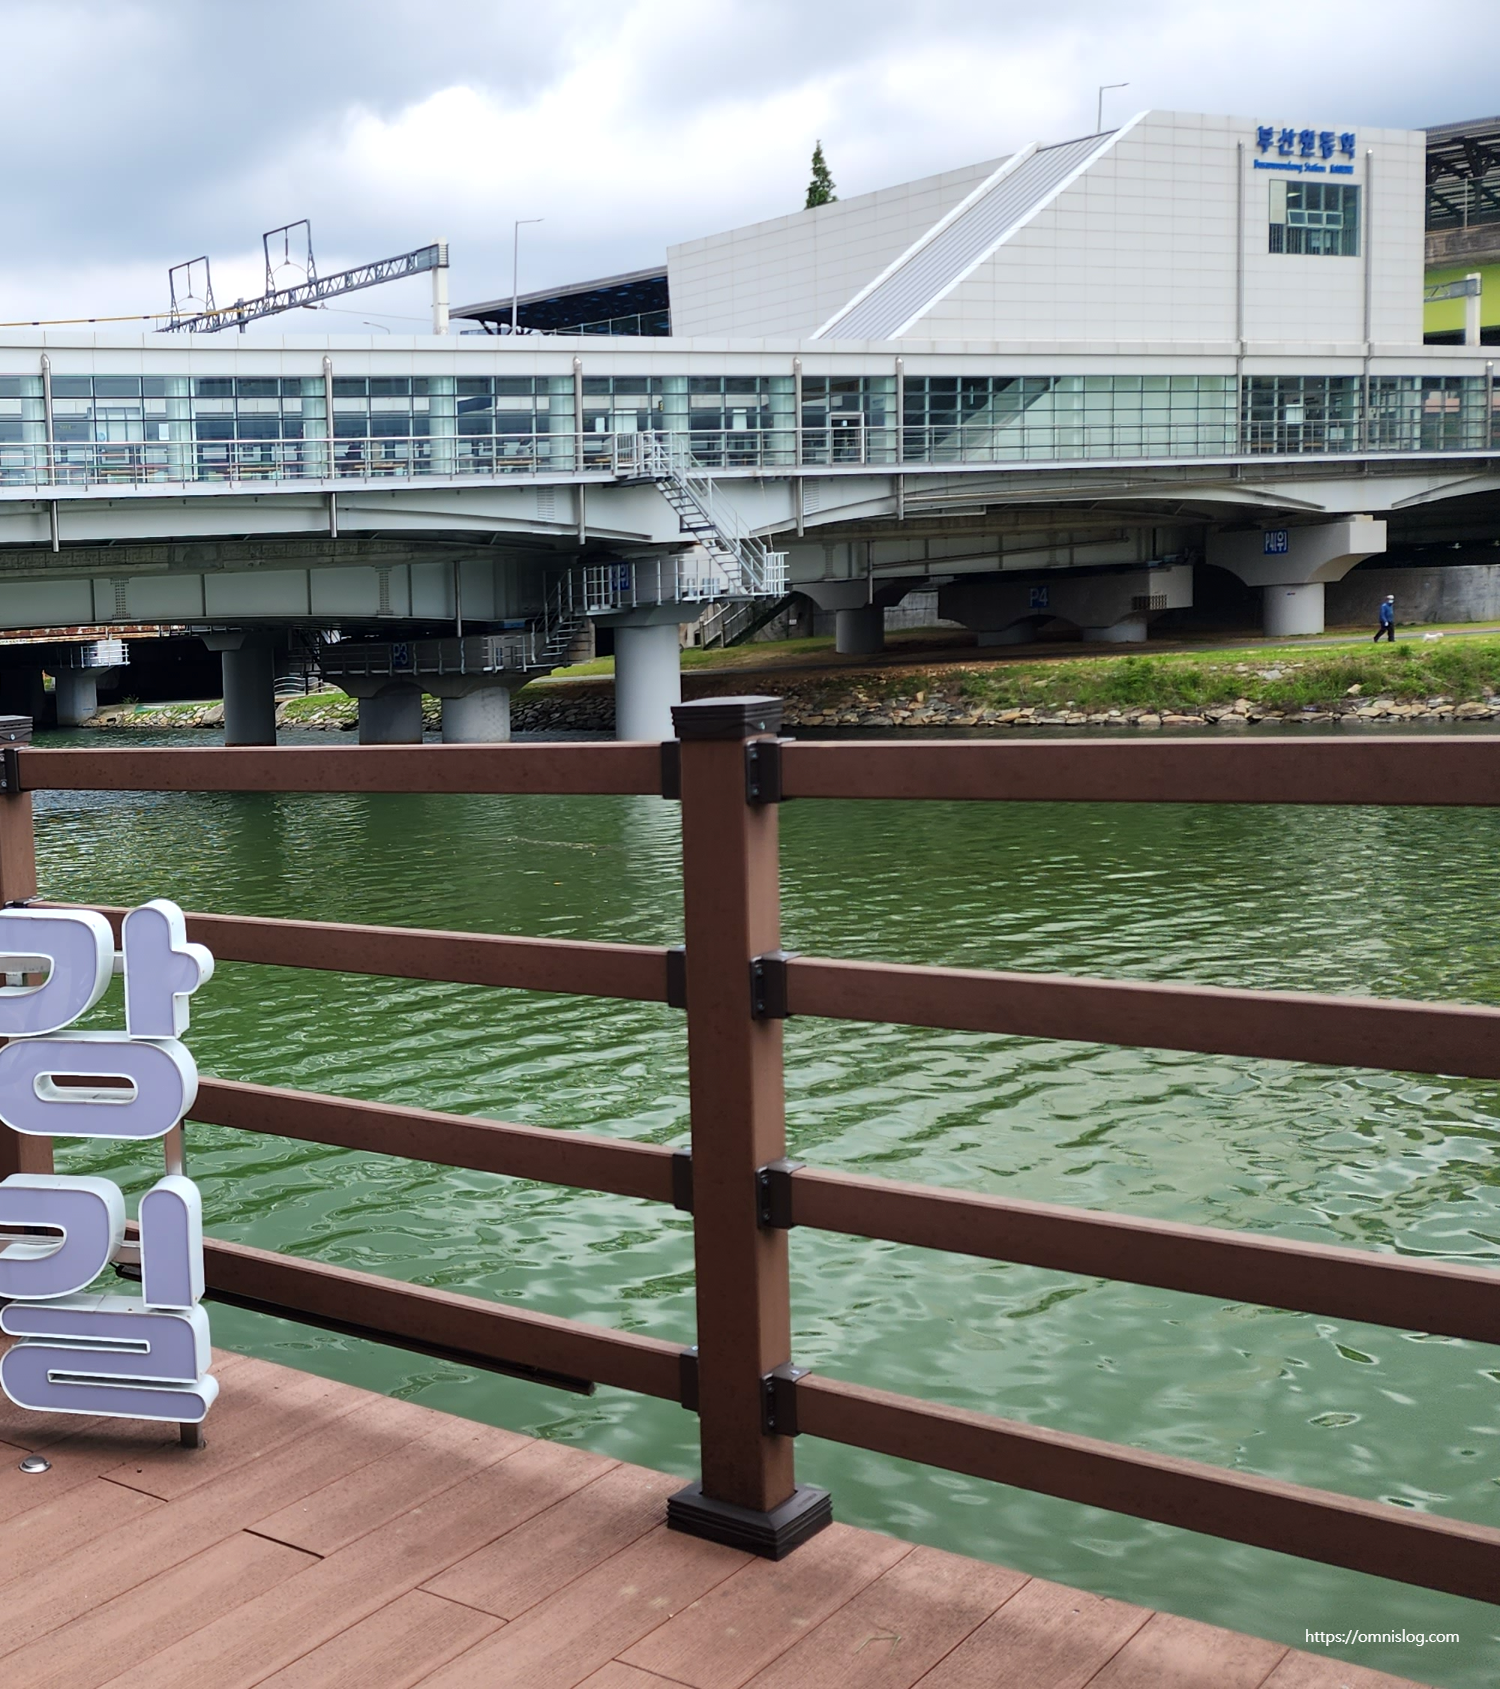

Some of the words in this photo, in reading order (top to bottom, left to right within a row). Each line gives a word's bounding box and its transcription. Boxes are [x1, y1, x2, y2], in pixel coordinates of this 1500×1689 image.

[1257, 126, 1356, 159] 부산원동역
[1030, 587, 1048, 607] P4
[393, 643, 408, 666] P3
